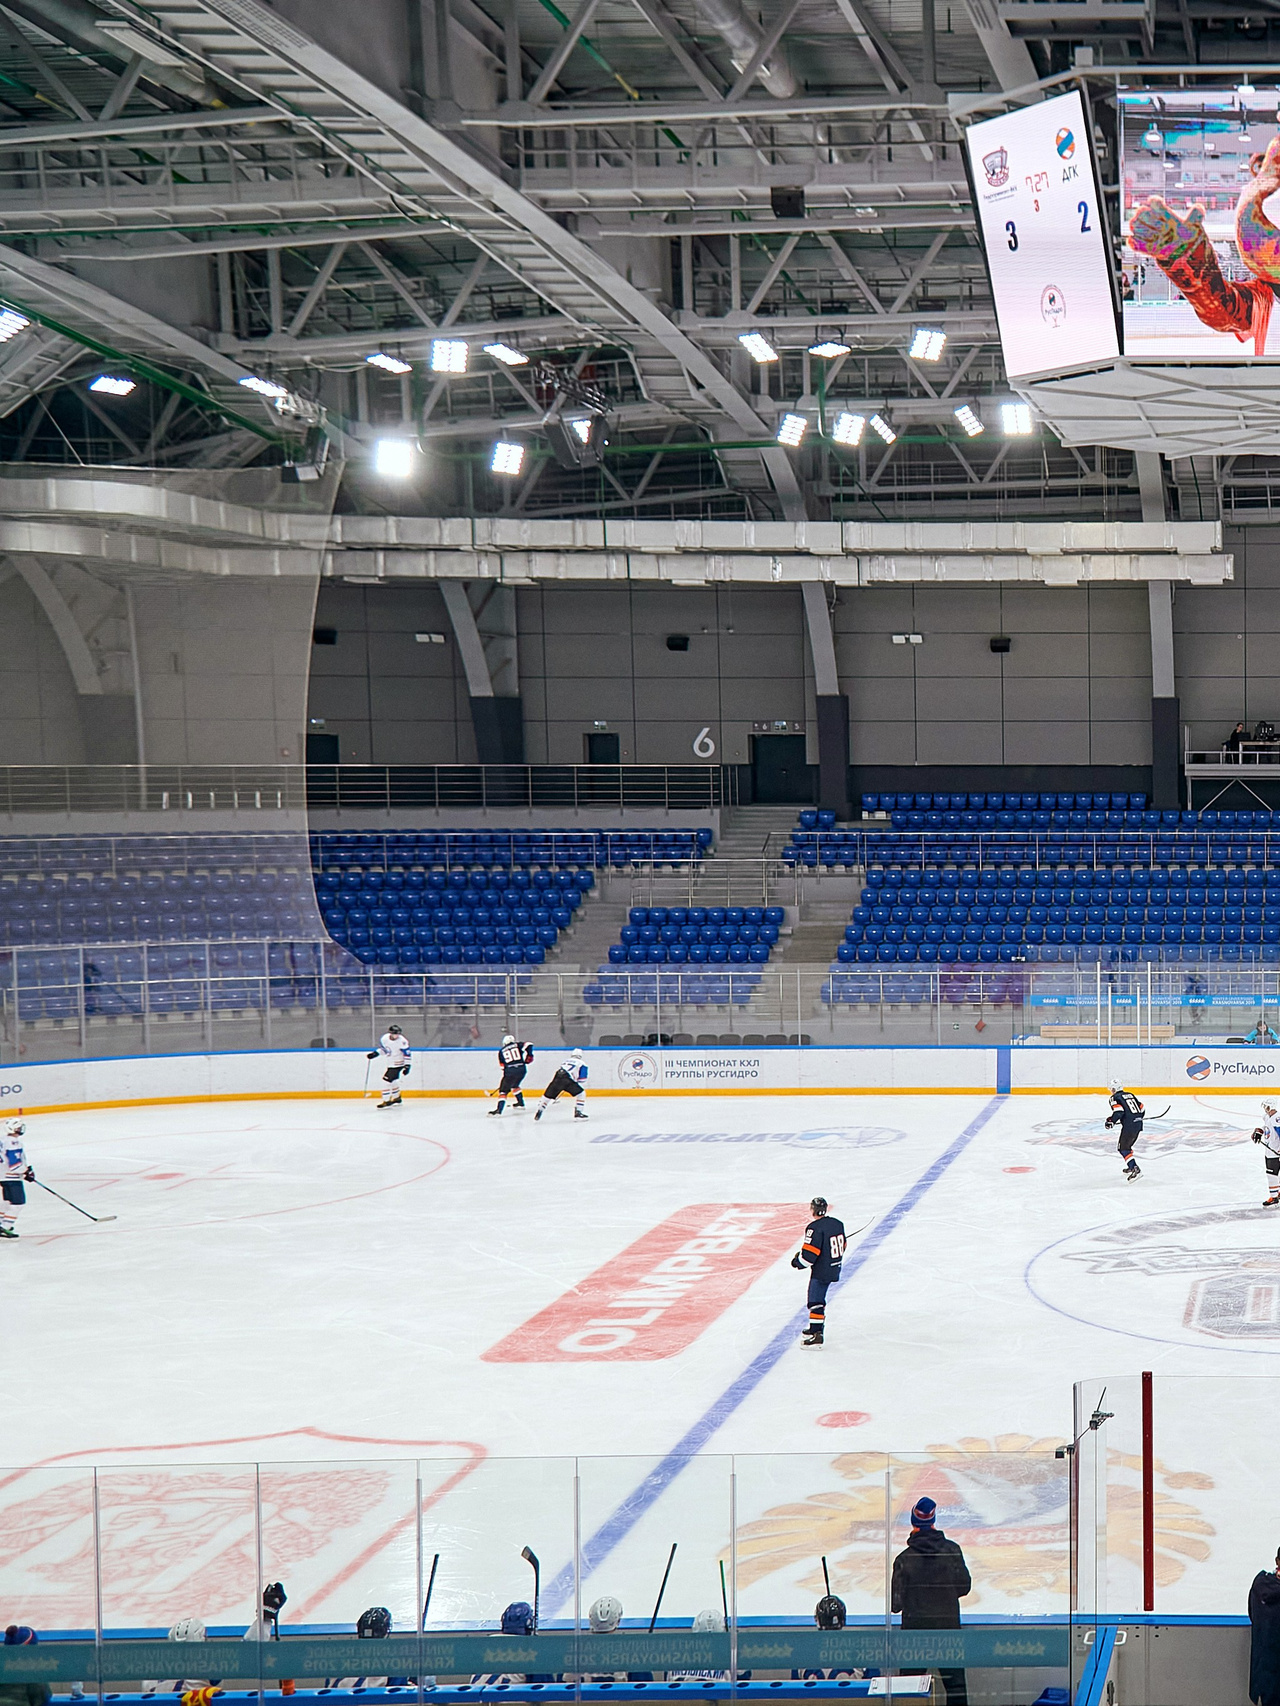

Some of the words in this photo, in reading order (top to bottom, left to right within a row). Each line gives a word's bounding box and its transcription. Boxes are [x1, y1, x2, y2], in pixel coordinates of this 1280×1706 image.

[1062, 164, 1079, 183] ДГК
[1034, 199, 1040, 212] 3
[1077, 200, 1091, 234] 2
[1005, 220, 1019, 252] 3
[693, 727, 715, 758] 6
[502, 1047, 521, 1064] 90
[707, 1070, 759, 1079] РУСГИДРО
[1213, 1062, 1275, 1076] РусГидро
[1126, 1099, 1142, 1114] 81
[590, 1132, 796, 1143] БУРЭНЕРГО
[829, 1234, 844, 1259] 88
[558, 1208, 777, 1353] OLIMPBET
